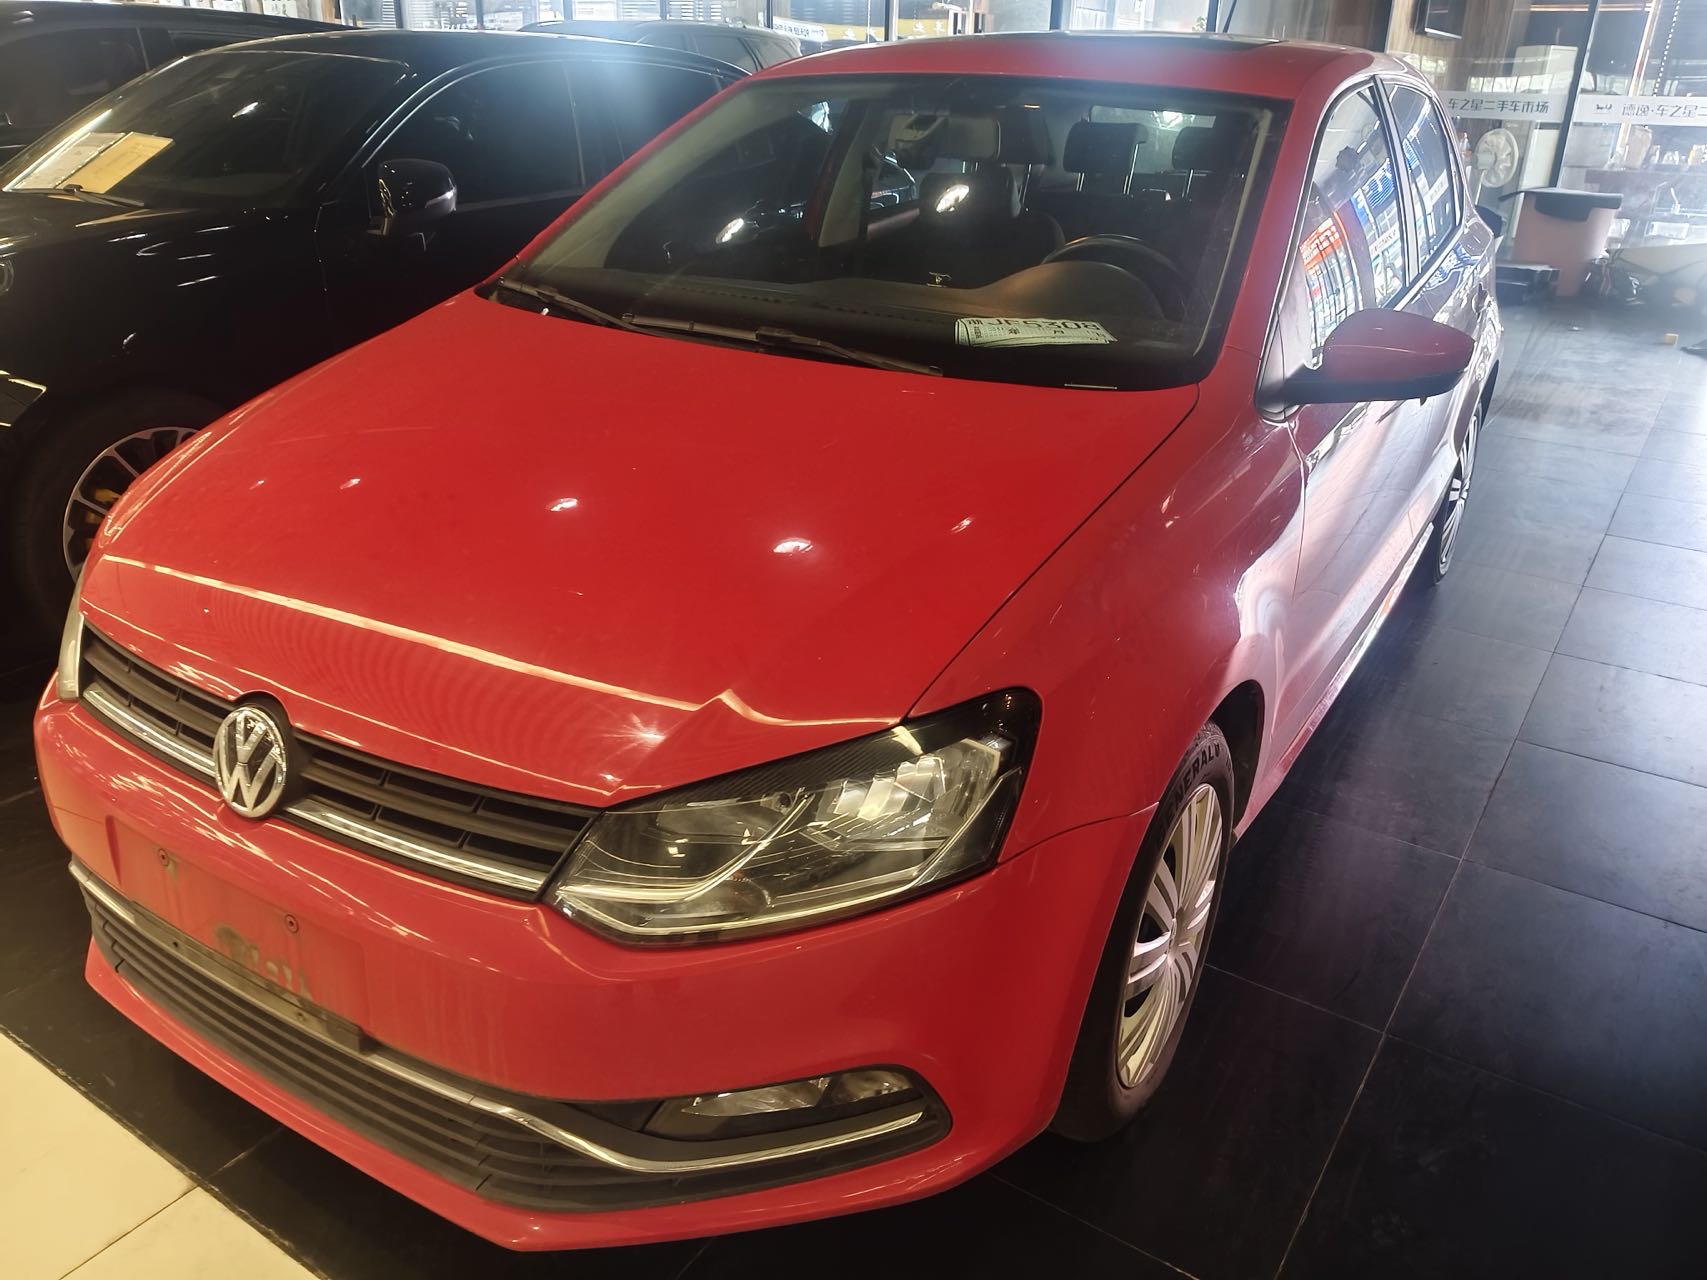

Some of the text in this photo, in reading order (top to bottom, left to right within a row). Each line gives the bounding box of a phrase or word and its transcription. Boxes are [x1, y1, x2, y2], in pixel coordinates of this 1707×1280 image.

[1447, 97, 1550, 114] 车之星二手车市场
